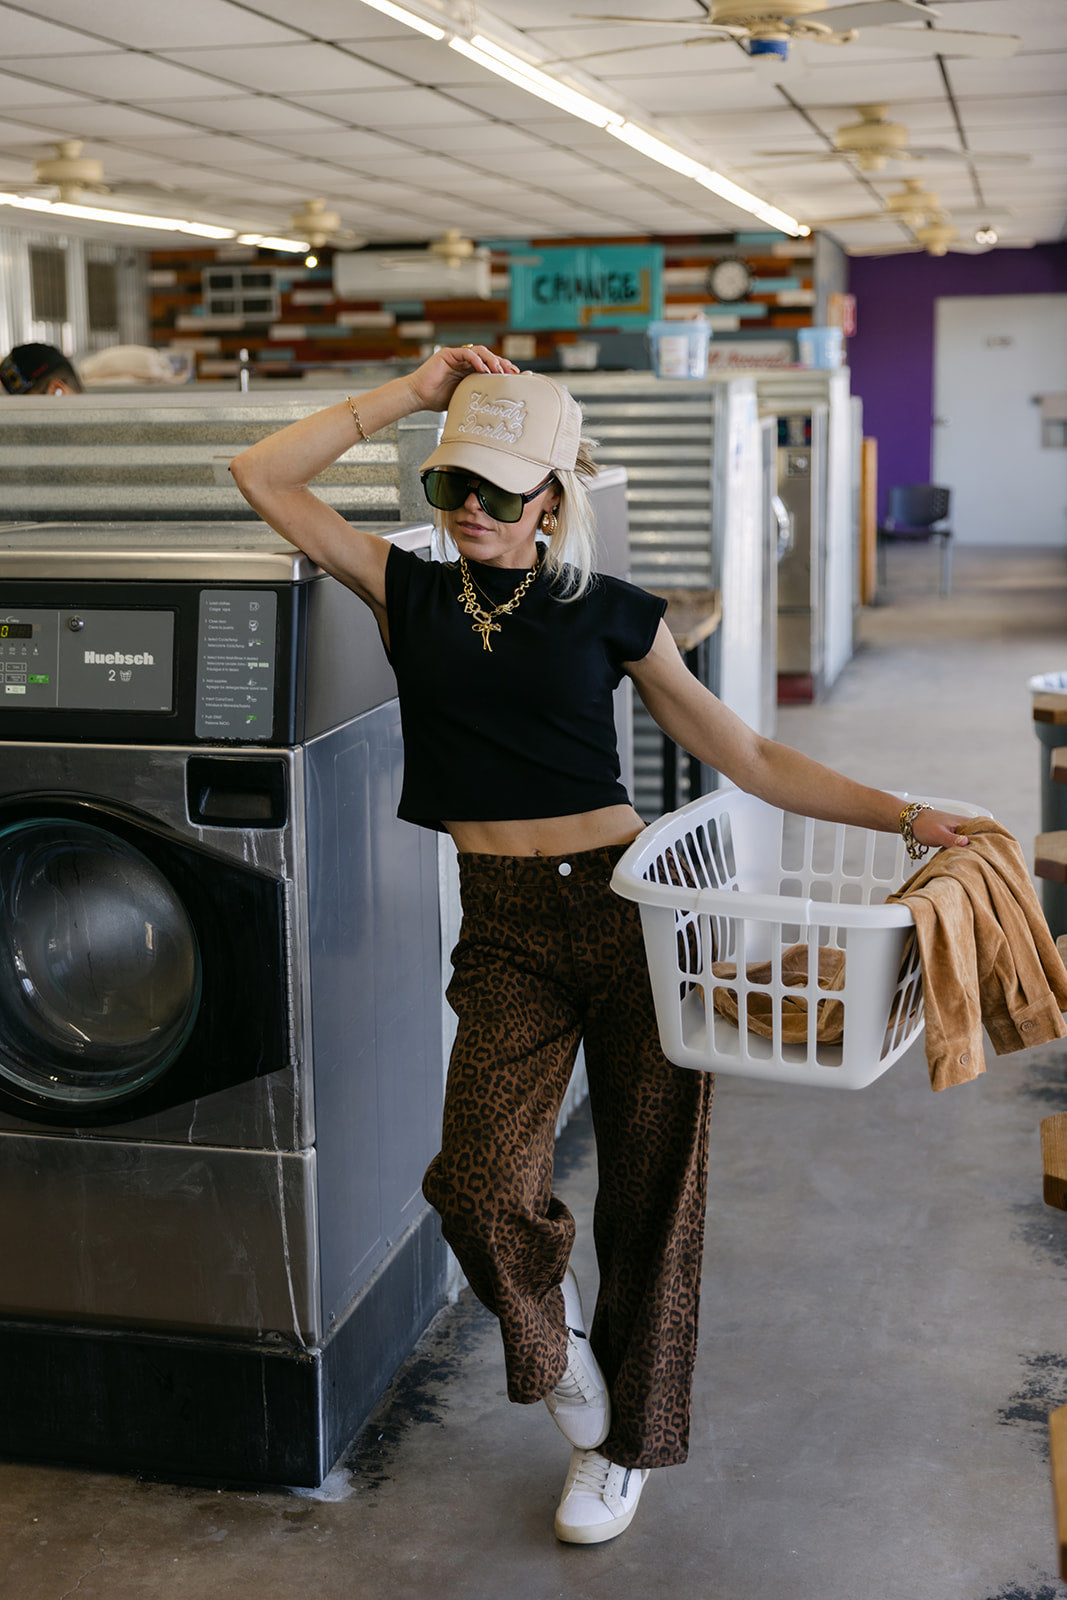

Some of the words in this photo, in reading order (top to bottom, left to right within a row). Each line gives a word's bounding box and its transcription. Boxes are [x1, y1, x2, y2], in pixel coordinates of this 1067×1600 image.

[469, 391, 528, 429] Howdy
[84, 651, 154, 665] Huebsch
[108, 669, 116, 682] 2
